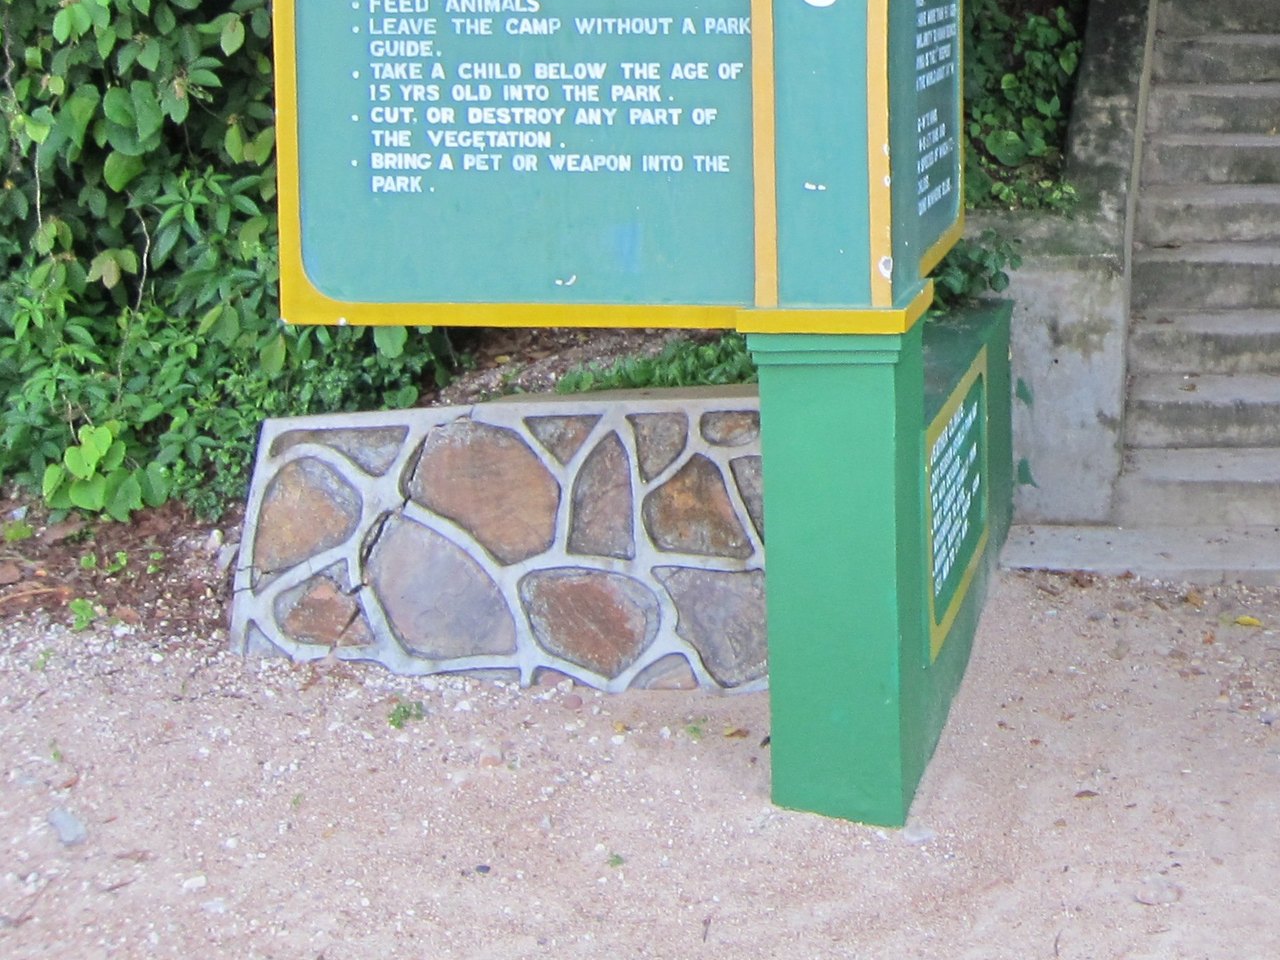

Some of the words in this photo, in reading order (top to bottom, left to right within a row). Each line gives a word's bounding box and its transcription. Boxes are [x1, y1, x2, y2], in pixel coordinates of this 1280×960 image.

[369, 17, 437, 36] LEAVE
[451, 17, 493, 36] THE
[505, 17, 561, 36] CAMP
[574, 17, 673, 36] WITHOUT
[682, 17, 697, 36] A
[704, 17, 752, 36] PARK
[370, 40, 442, 58] GUIDE.
[370, 62, 423, 81] TAKE
[431, 62, 446, 81] A
[458, 62, 522, 81] CHILD
[534, 62, 607, 81] BELOW
[620, 62, 661, 81] THE
[670, 62, 709, 81] AGE
[718, 62, 744, 81] OF
[369, 84, 391, 102] 15
[399, 84, 440, 102] YRS
[451, 84, 492, 102] OLD
[503, 84, 550, 102] INTO
[562, 84, 600, 102] THE
[426, 106, 455, 126] OR
[467, 106, 566, 126] DESTROY
[575, 106, 618, 126] ANY
[629, 106, 683, 126] PART
[691, 106, 718, 126] OF
[371, 129, 412, 149] THE
[371, 153, 433, 173] BRING
[439, 153, 454, 173] A
[463, 153, 503, 173] PET
[512, 153, 538, 173] OR
[548, 153, 632, 173] WEAPON
[642, 153, 684, 173] INTO
[693, 153, 730, 173] THE
